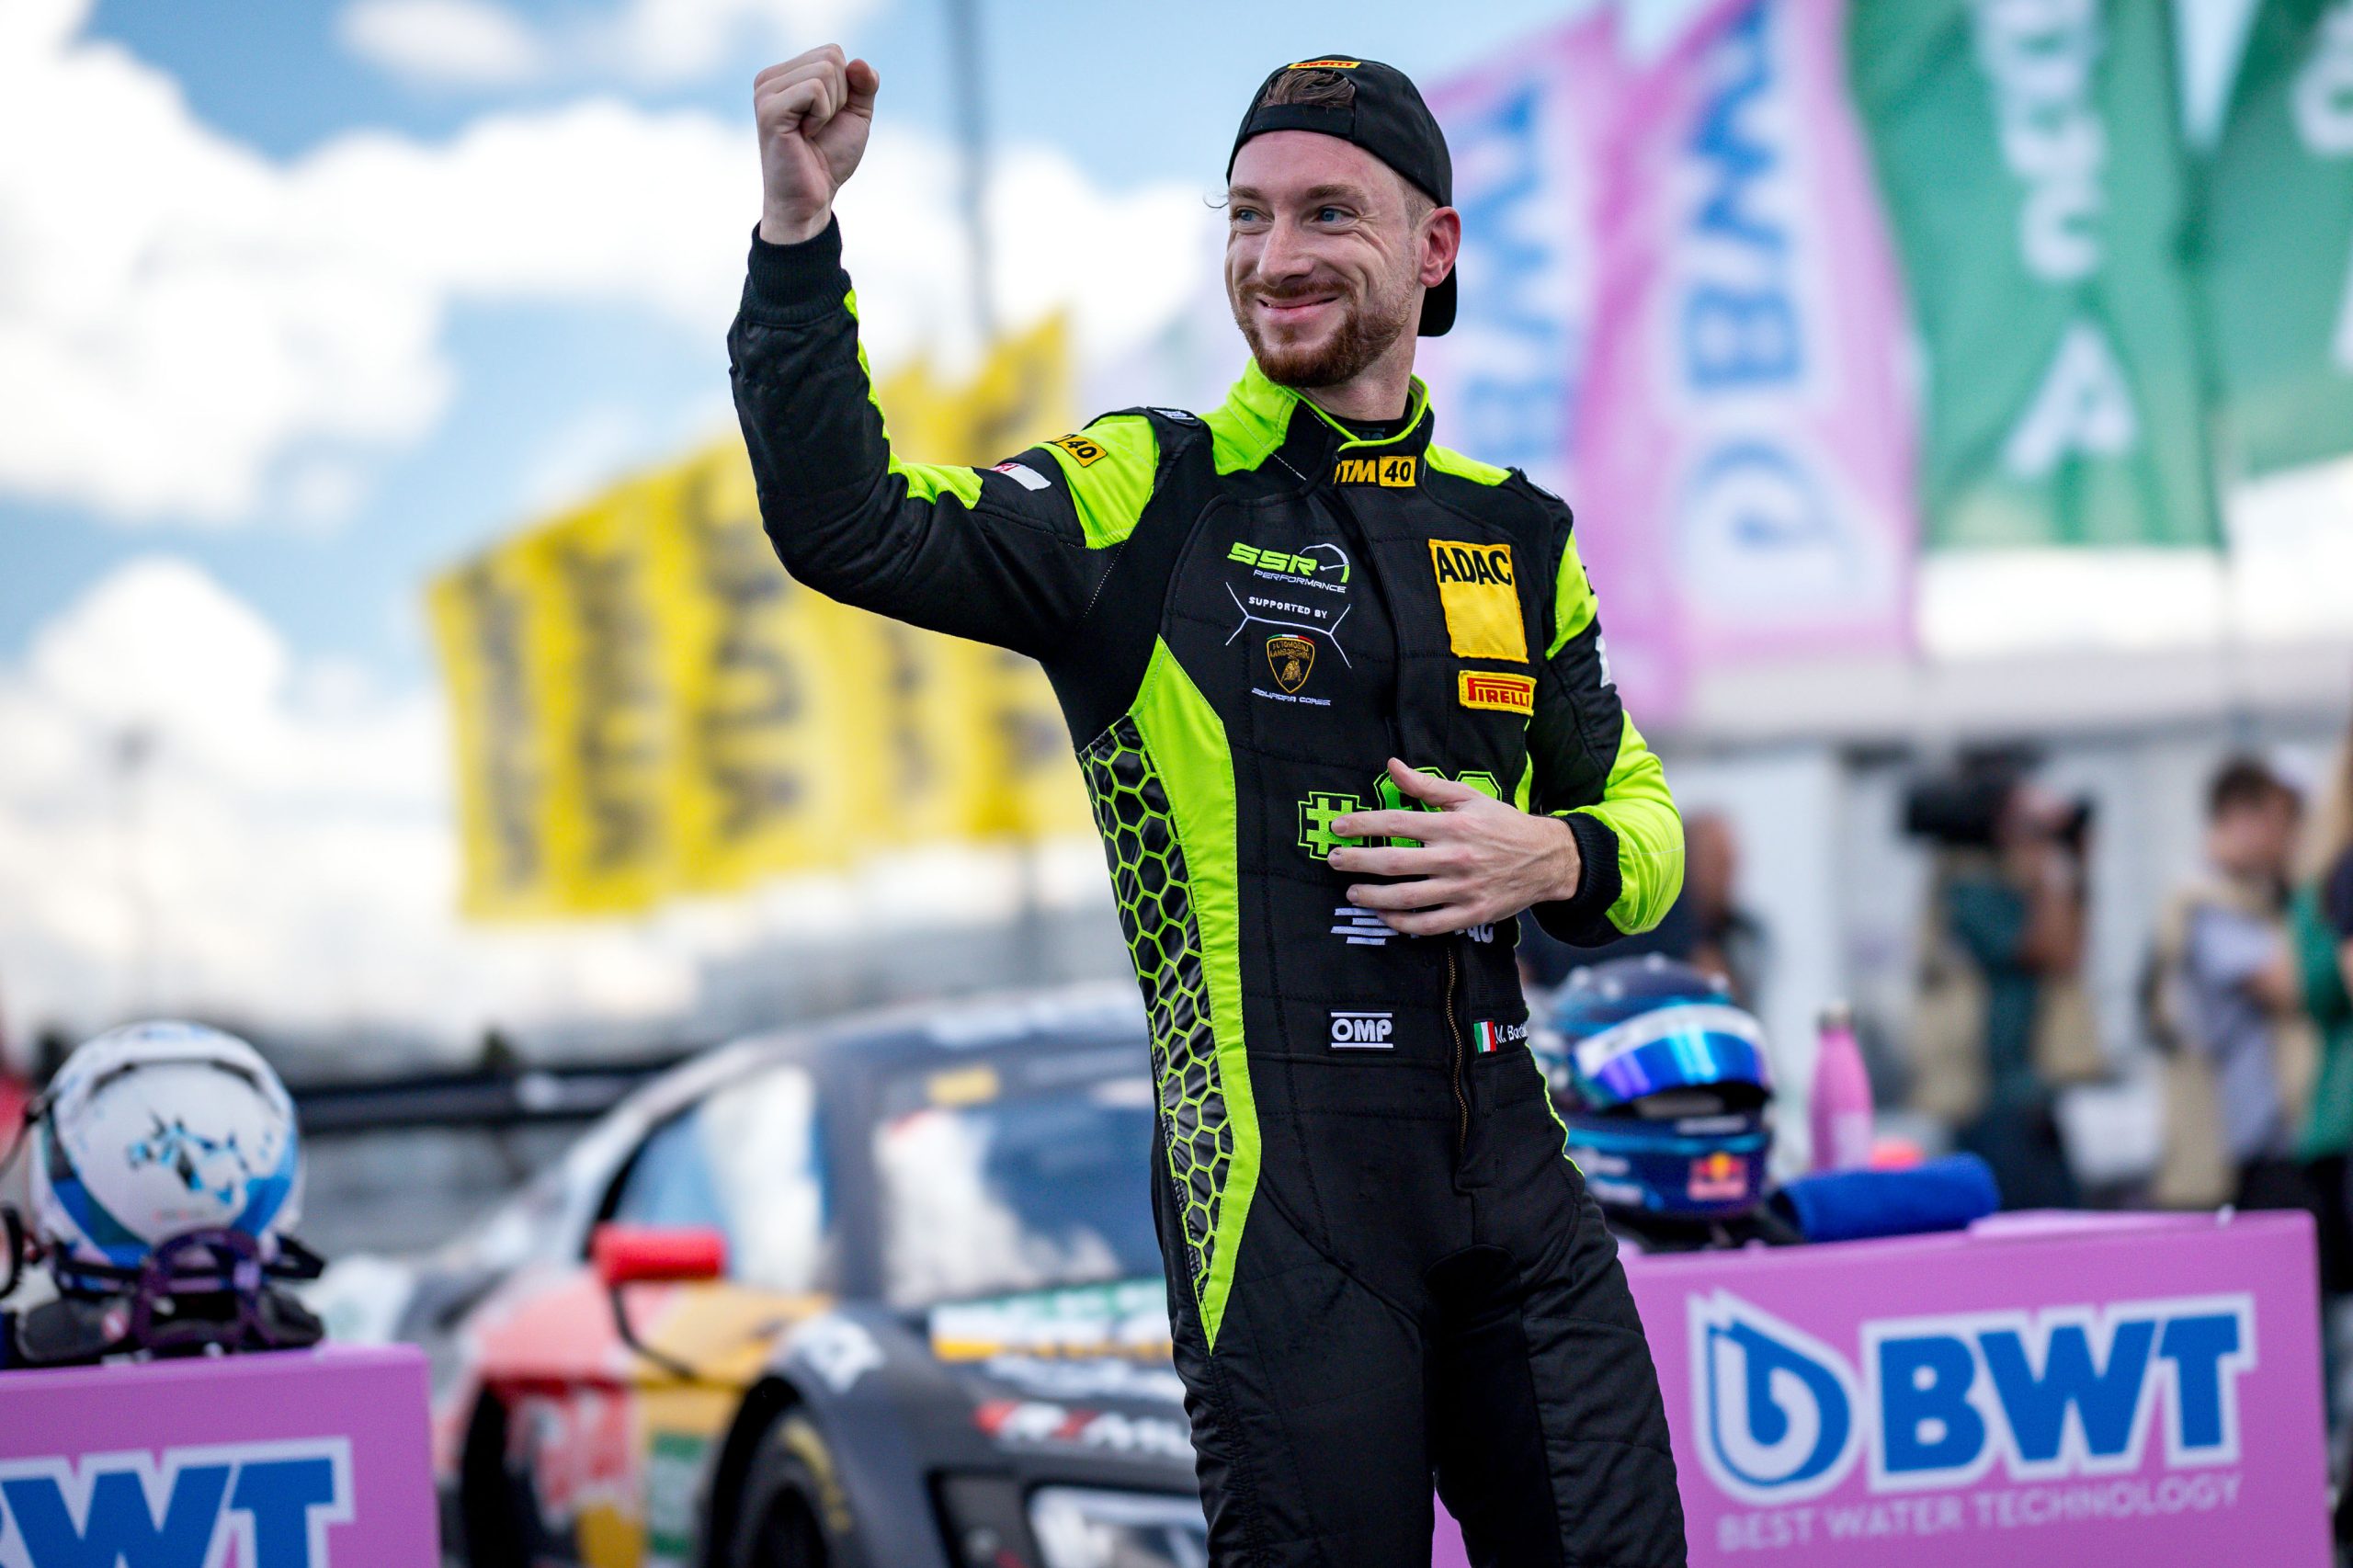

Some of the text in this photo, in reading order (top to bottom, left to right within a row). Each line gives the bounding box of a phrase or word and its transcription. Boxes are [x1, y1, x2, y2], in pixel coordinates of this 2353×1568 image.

[1065, 439, 1098, 460] 40
[1334, 460, 1412, 484] TM 40
[1226, 541, 1318, 576] SSR
[1436, 546, 1513, 586] ADAC
[1253, 569, 1347, 594] PERFORMANCE
[1248, 596, 1328, 619] SUPPORTED BY
[1299, 696, 1332, 706] CORSE
[1467, 676, 1531, 708] PIRELLI
[1331, 1017, 1393, 1043] OMP
[1864, 1296, 2254, 1491] BWT
[0, 1445, 349, 1568] WT
[1716, 1471, 2245, 1553] BEST WATER TECHNOLOGY
